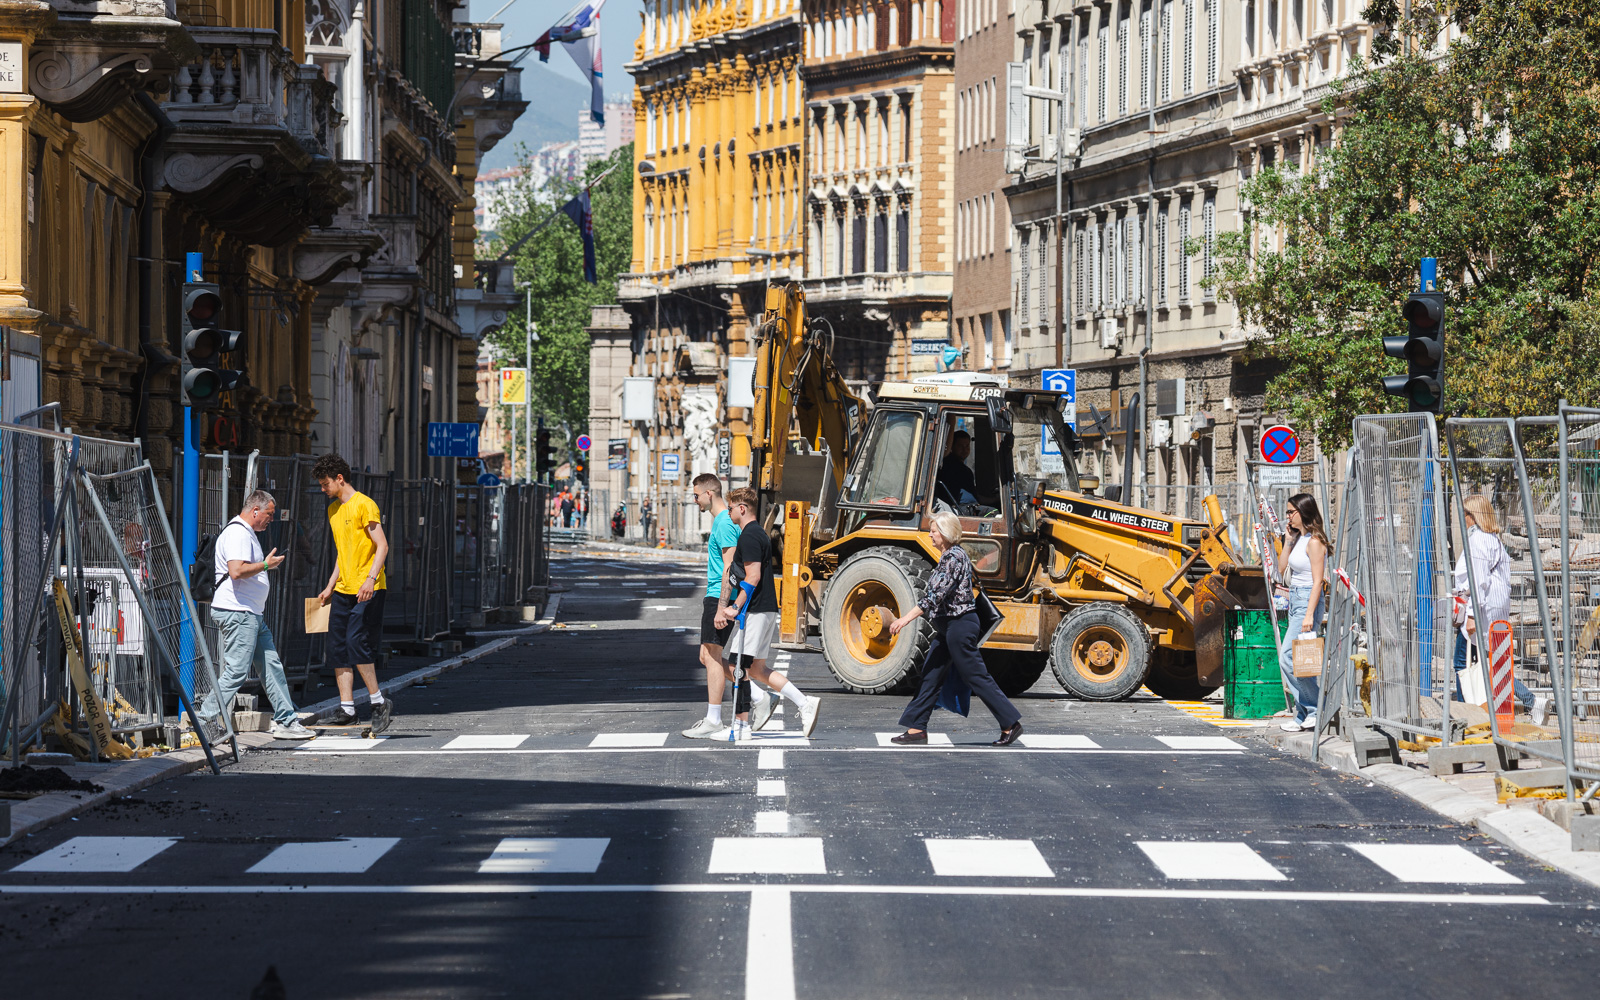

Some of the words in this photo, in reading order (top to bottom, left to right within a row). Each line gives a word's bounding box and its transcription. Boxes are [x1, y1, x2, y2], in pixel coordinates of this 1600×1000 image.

[1050, 379, 1067, 391] P
[1043, 499, 1074, 514] TURBO
[1091, 508, 1108, 521] ALL
[1109, 512, 1139, 526] WHEEL
[1140, 517, 1169, 532] STEER
[81, 688, 100, 720] POZOR
